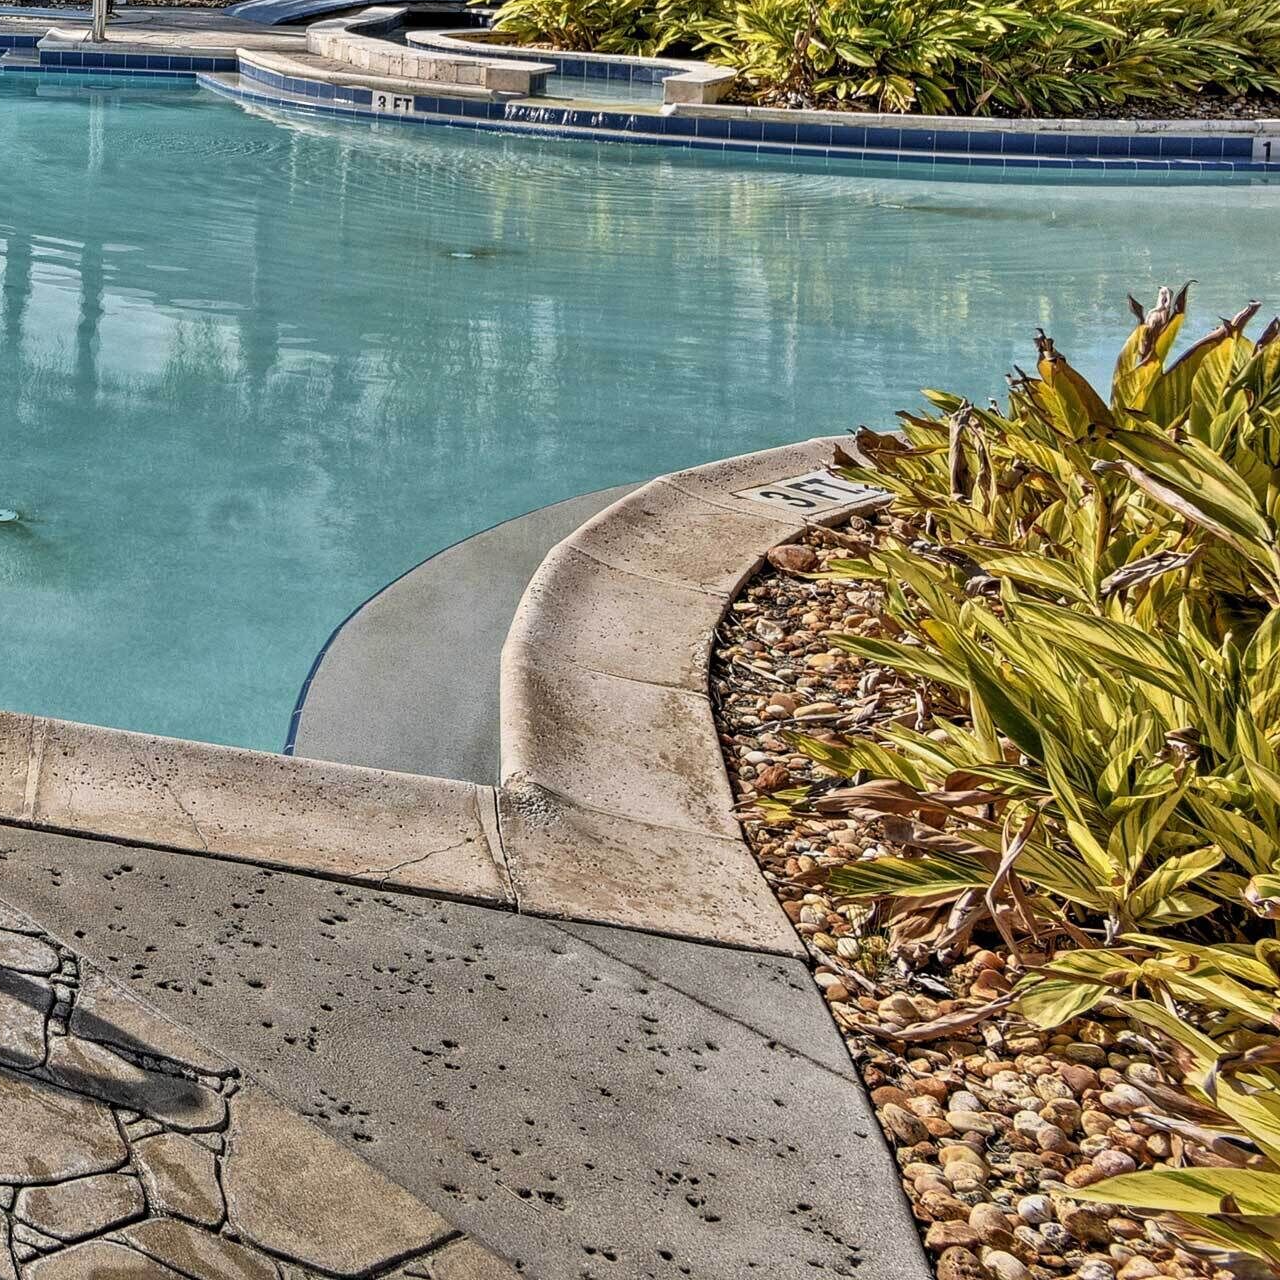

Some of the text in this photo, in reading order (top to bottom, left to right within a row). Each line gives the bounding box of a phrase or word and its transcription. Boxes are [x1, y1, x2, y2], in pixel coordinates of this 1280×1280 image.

[378, 95, 413, 111] 3 FT
[1262, 141, 1272, 162] 1
[759, 491, 817, 508] 3
